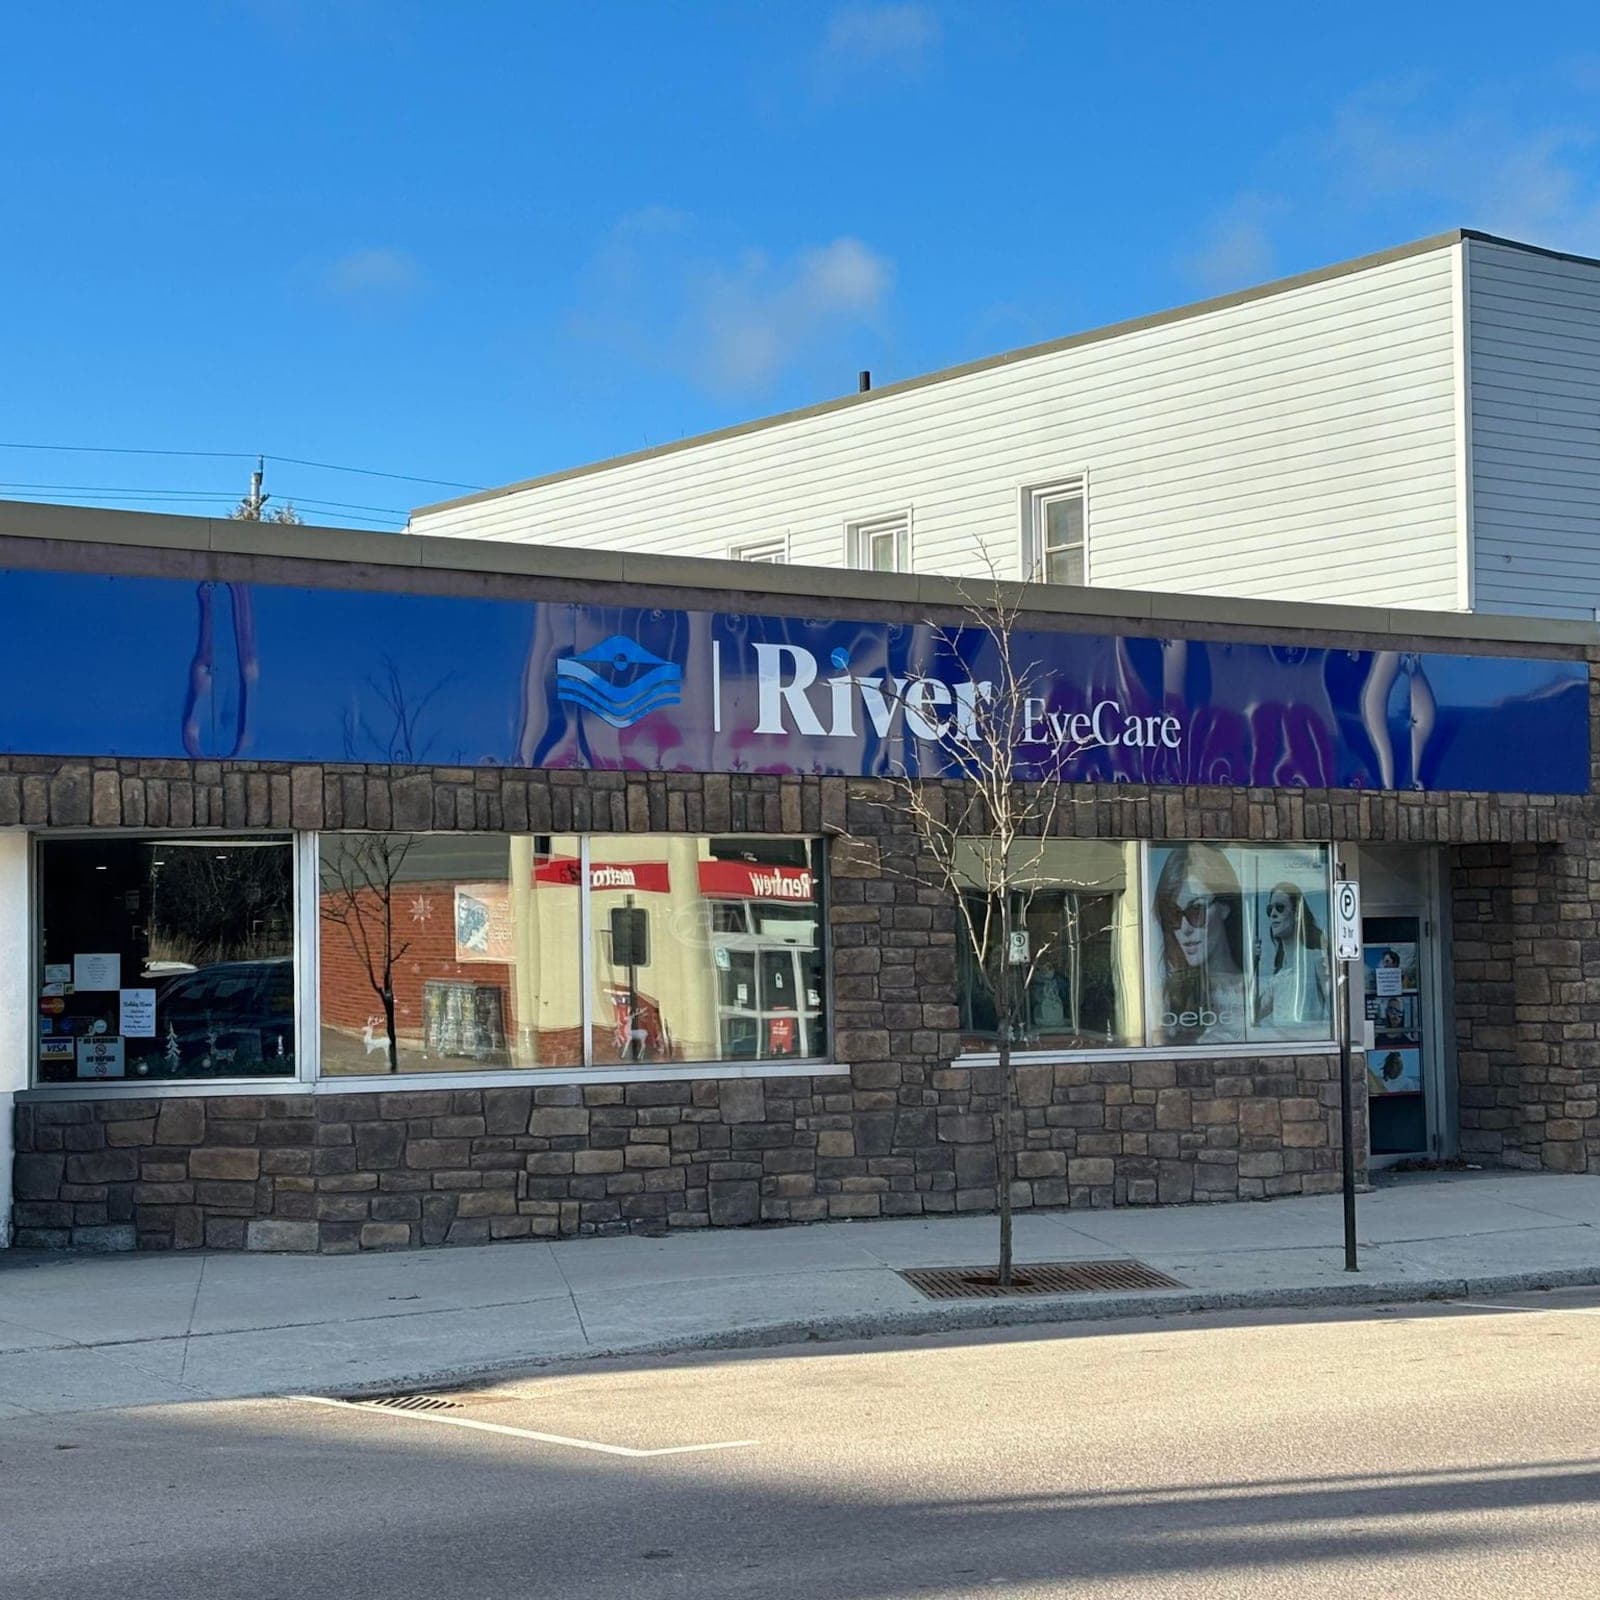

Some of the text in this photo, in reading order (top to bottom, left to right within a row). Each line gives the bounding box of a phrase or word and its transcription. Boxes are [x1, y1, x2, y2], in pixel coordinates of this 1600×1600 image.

[752, 642, 992, 742] River
[1022, 697, 1182, 754] EyeCare
[1344, 894, 1352, 913] P
[1160, 1006, 1234, 1027] bebe
[46, 1044, 68, 1053] VISA
